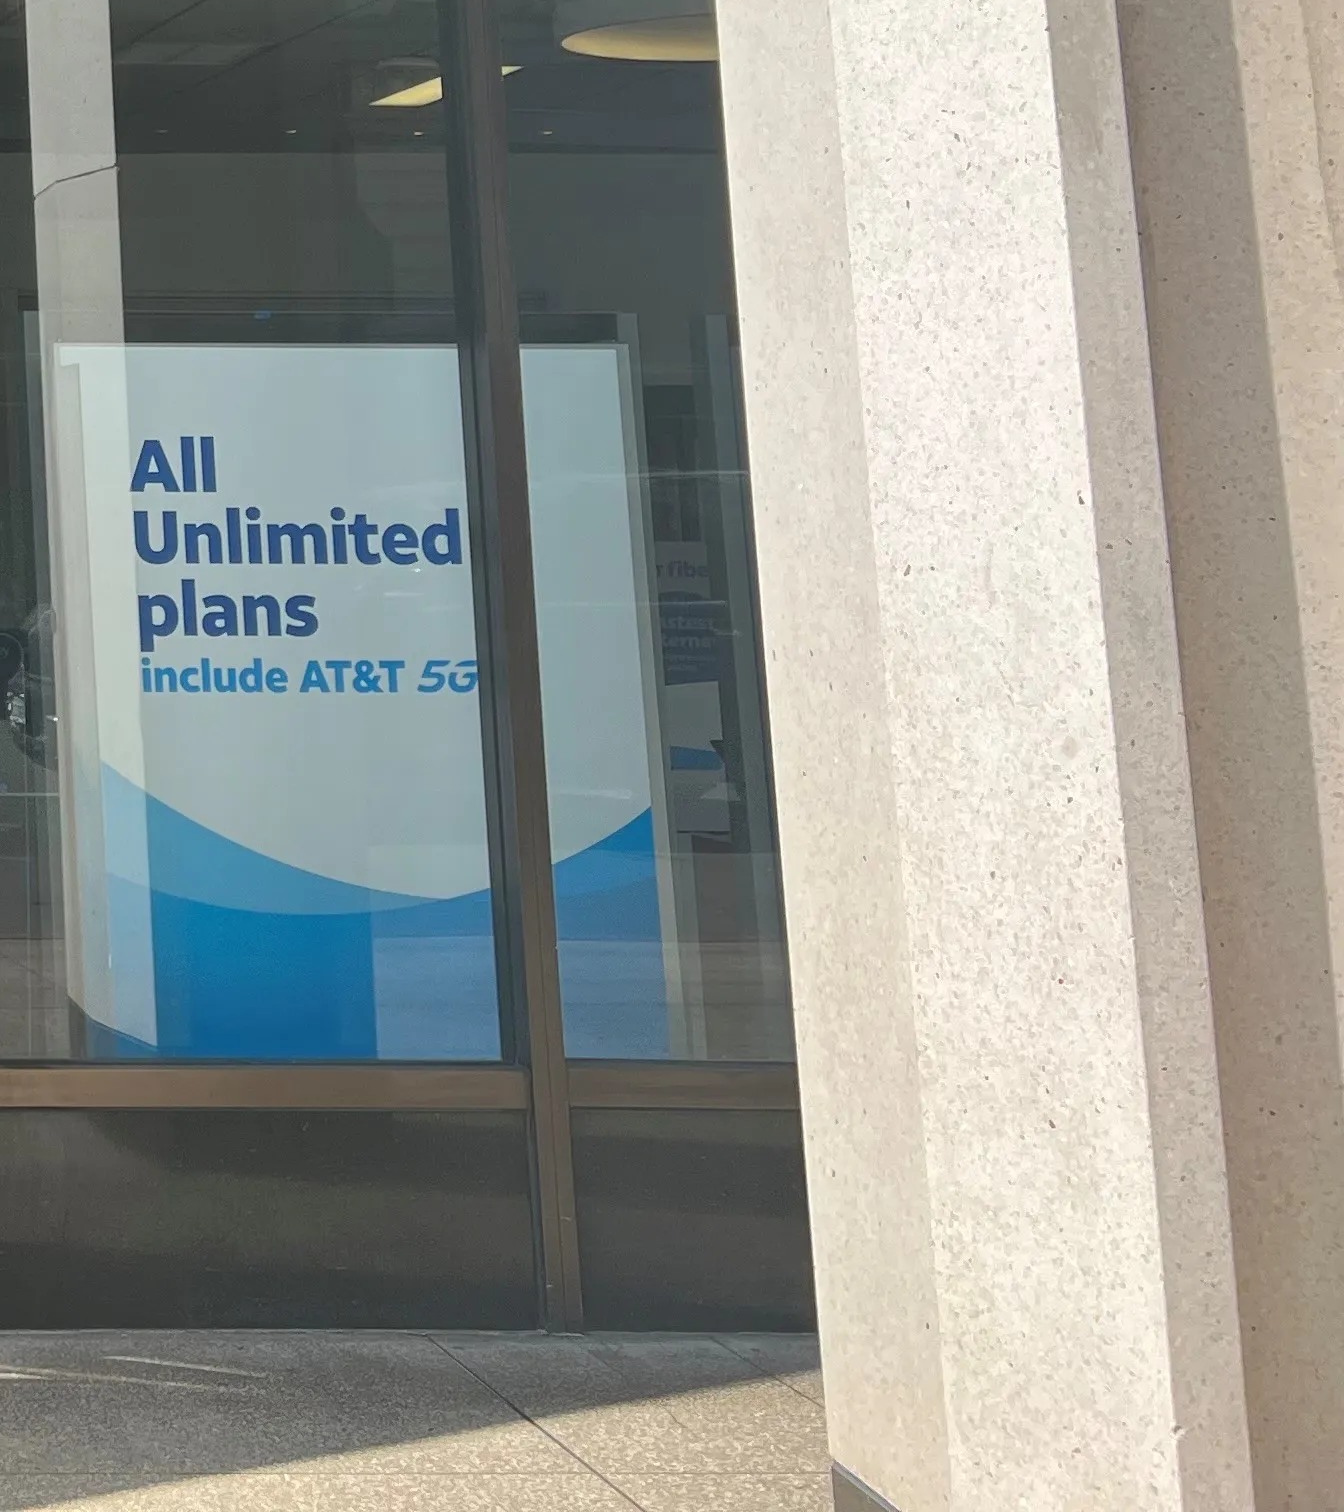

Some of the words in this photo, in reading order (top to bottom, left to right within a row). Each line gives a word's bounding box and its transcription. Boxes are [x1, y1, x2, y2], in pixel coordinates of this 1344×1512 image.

[129, 436, 217, 492] All
[133, 506, 463, 566] Unlimited
[137, 579, 319, 652] plans
[141, 657, 288, 694] include
[299, 660, 405, 694] AT&T
[417, 660, 479, 693] 5G
